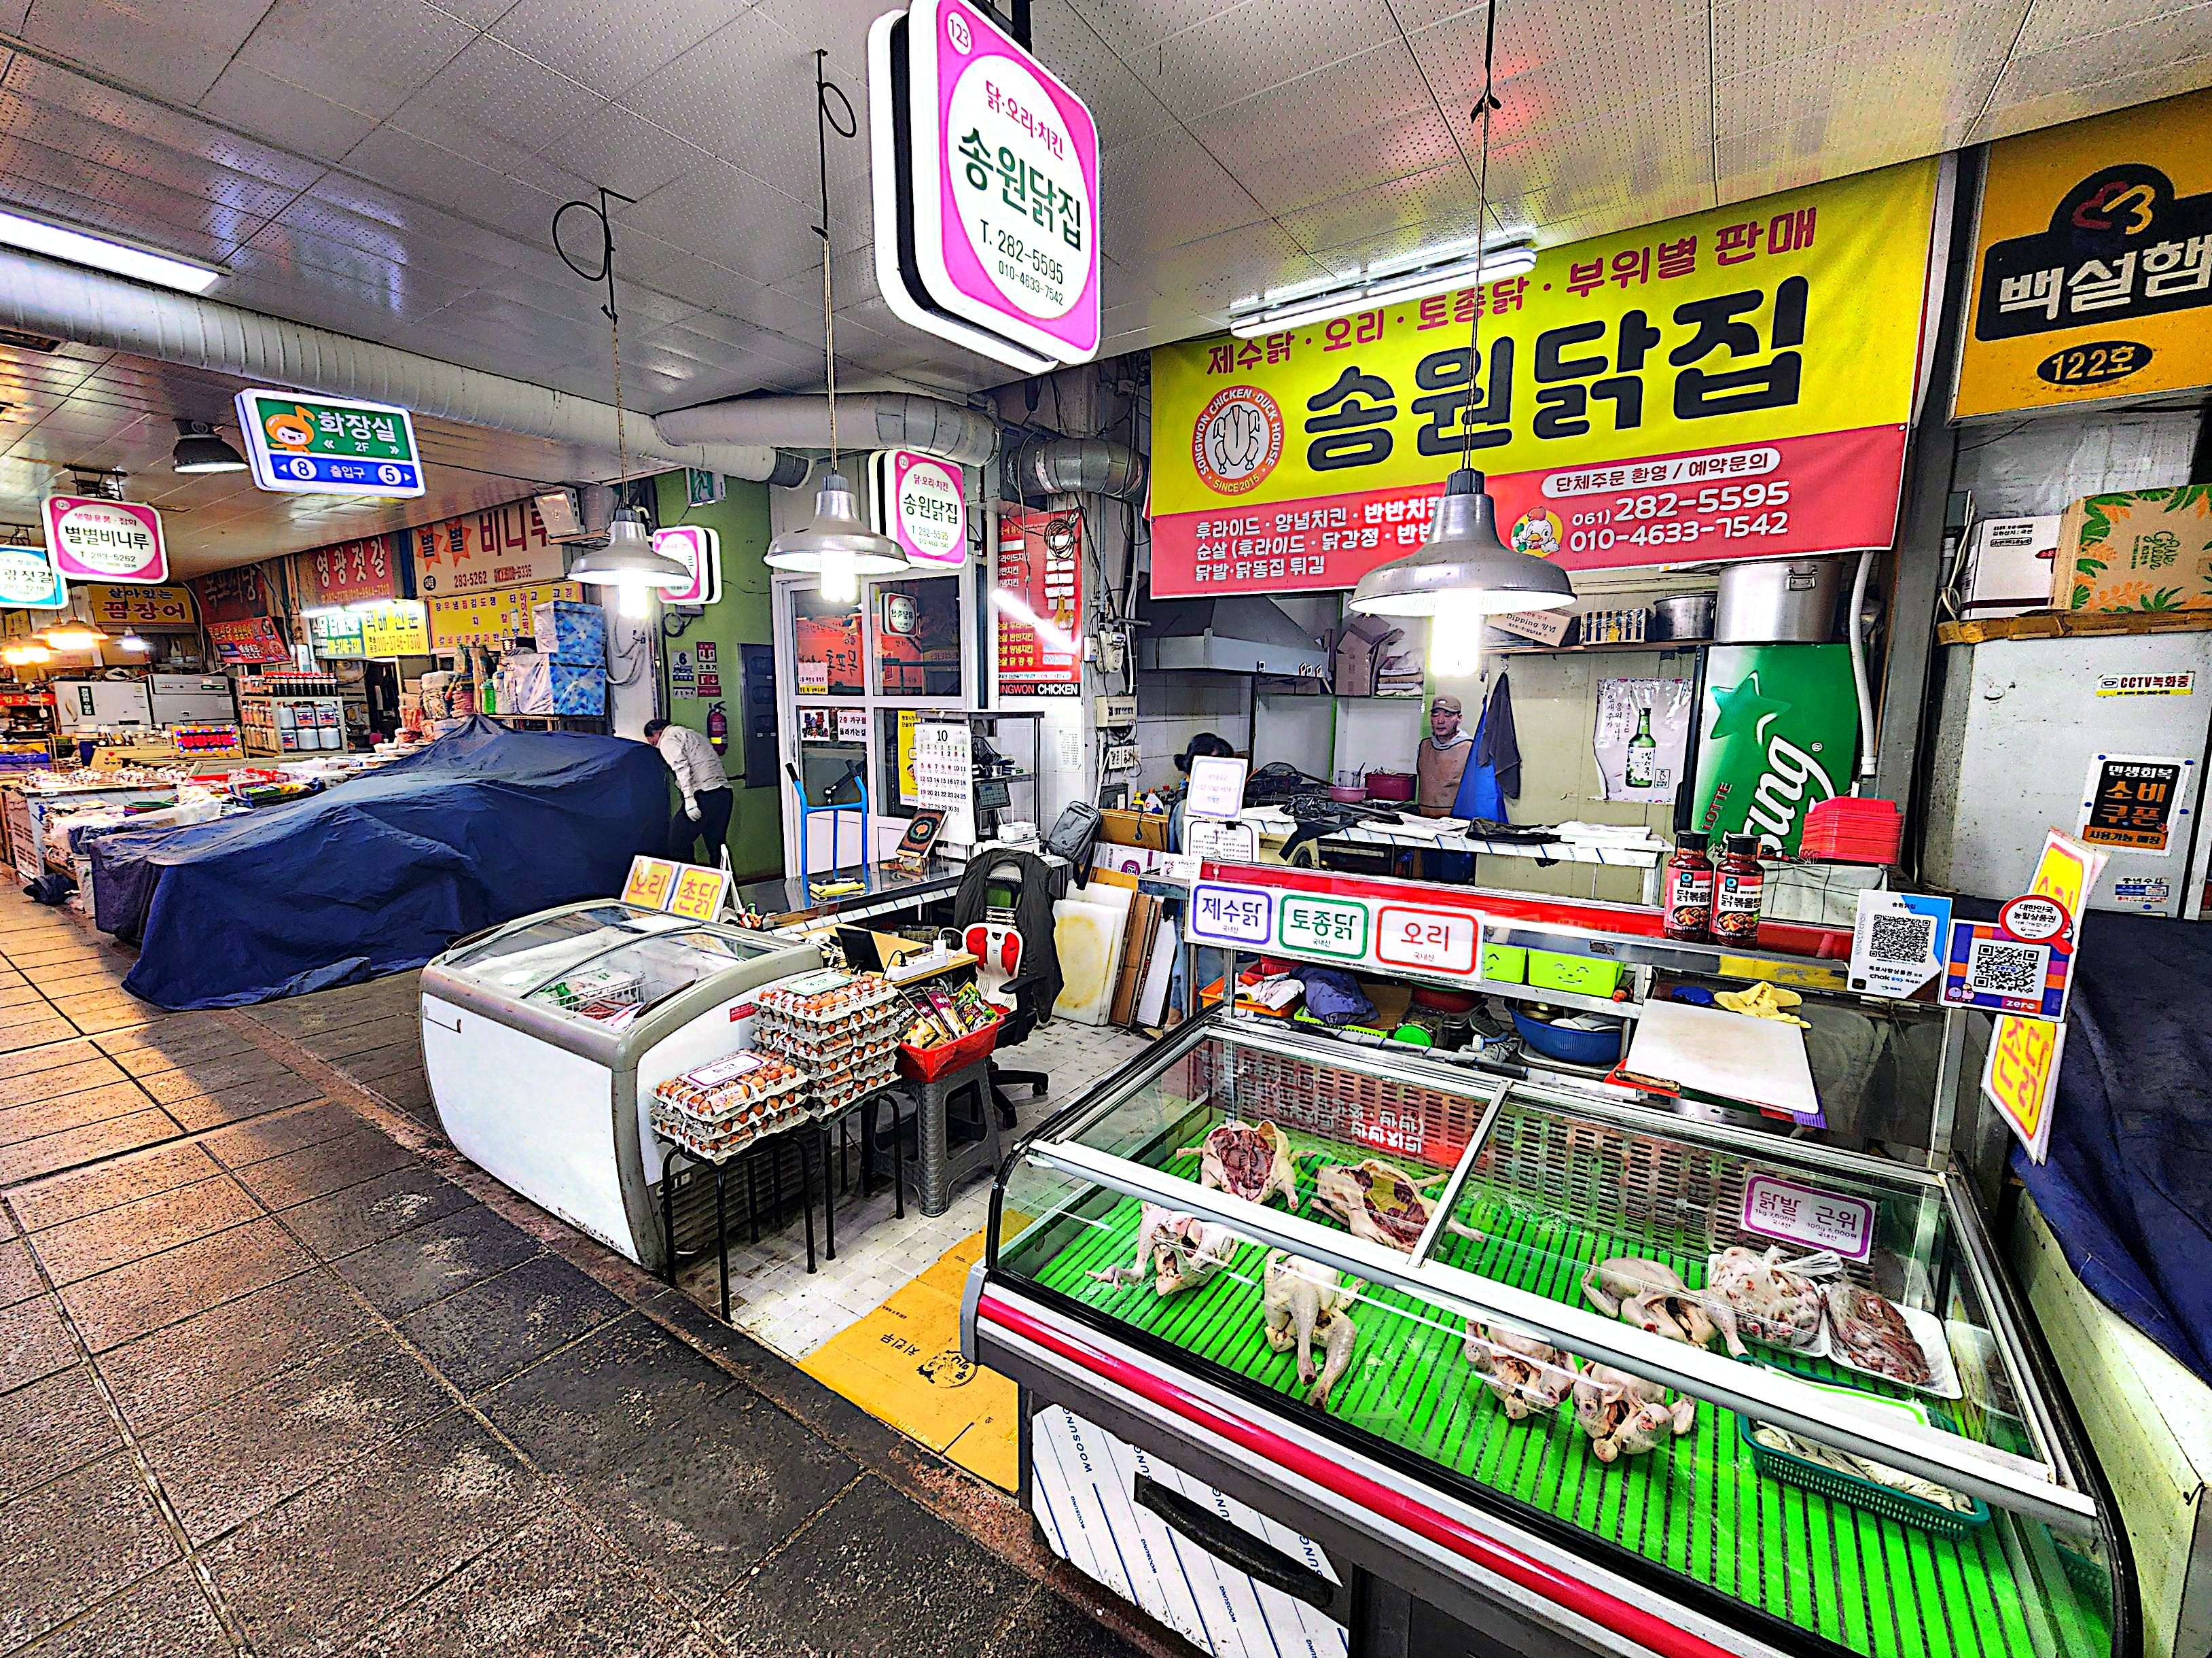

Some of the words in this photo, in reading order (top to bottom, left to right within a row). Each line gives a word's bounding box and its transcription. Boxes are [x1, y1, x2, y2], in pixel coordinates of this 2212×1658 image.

[949, 18, 969, 48] 123
[985, 80, 1063, 161] 닭·오리·치킨
[957, 127, 1082, 251] 송원닭집
[998, 229, 1064, 284] 282-5595
[998, 262, 1064, 306] 010-4633-7542
[1206, 332, 1296, 376] 제수닭
[1323, 308, 1386, 353] 오리
[1416, 276, 1530, 332] 토종닭
[1567, 234, 1698, 298] 부위별
[1714, 206, 1818, 267] 판매
[1999, 233, 2212, 321] 백설햄
[1304, 274, 1809, 473] 송원닭집
[2050, 344, 2136, 383] 122호
[317, 410, 398, 443] 화장실
[353, 442, 370, 453] 2F
[1195, 414, 1211, 476] SONGWON
[1265, 422, 1281, 467] HOUSE
[297, 460, 310, 477] 8
[329, 464, 366, 479] 출입구
[385, 468, 396, 482] 5
[1213, 479, 1240, 493] SINCE
[1240, 474, 1260, 491] 2015
[1555, 470, 1625, 493] 단체주문
[1630, 464, 1667, 484] 환영
[1688, 451, 1769, 477] 예약문의
[904, 493, 958, 525] 송원닭집
[1613, 480, 1790, 522] 282-5595
[64, 525, 150, 550] 별별비니루
[1195, 516, 1260, 540] 후라이드
[1274, 507, 1347, 533] 양념치킨
[1569, 511, 1789, 552] 010-4633-7542
[1196, 541, 1228, 561] 순살
[1230, 535, 1306, 559] (후라이드
[1321, 527, 1379, 550] 닭강정
[316, 536, 387, 588] 영광젓갈
[1289, 554, 1325, 576] 튀김
[108, 587, 174, 600] 살아있는
[454, 570, 488, 588] 283-5262
[1505, 613, 1539, 628] Dipping
[1037, 684, 1078, 694] CHICKEN
[936, 730, 948, 741] 10
[2108, 765, 2173, 780] 민생회복
[1701, 781, 1732, 831] LOTTE
[2104, 781, 2166, 802] 소비
[2099, 804, 2160, 826] 쿠폰
[630, 872, 666, 904] 오리
[679, 878, 719, 916] 촌닭
[1202, 896, 1263, 927] 제수닭
[2012, 911, 2057, 923] 농할상품권
[2018, 903, 2054, 915] 대한민국
[1222, 925, 1239, 935] 국내산
[1289, 909, 1357, 941] 토종닭
[1400, 921, 1450, 952] 오리
[1313, 938, 1332, 948] 국내산
[1413, 951, 1435, 962] 국내산
[1869, 973, 1891, 981] chak
[2005, 999, 2037, 1010] zero
[1760, 1190, 1802, 1217] 닭발
[1815, 1205, 1857, 1231] 근위
[880, 1333, 921, 1357] 치킨무
[1070, 1496, 1086, 1530] WOOSUNG
[1140, 1538, 1158, 1574] WOOSUNG
[1218, 1585, 1237, 1623] WOOSUNG
